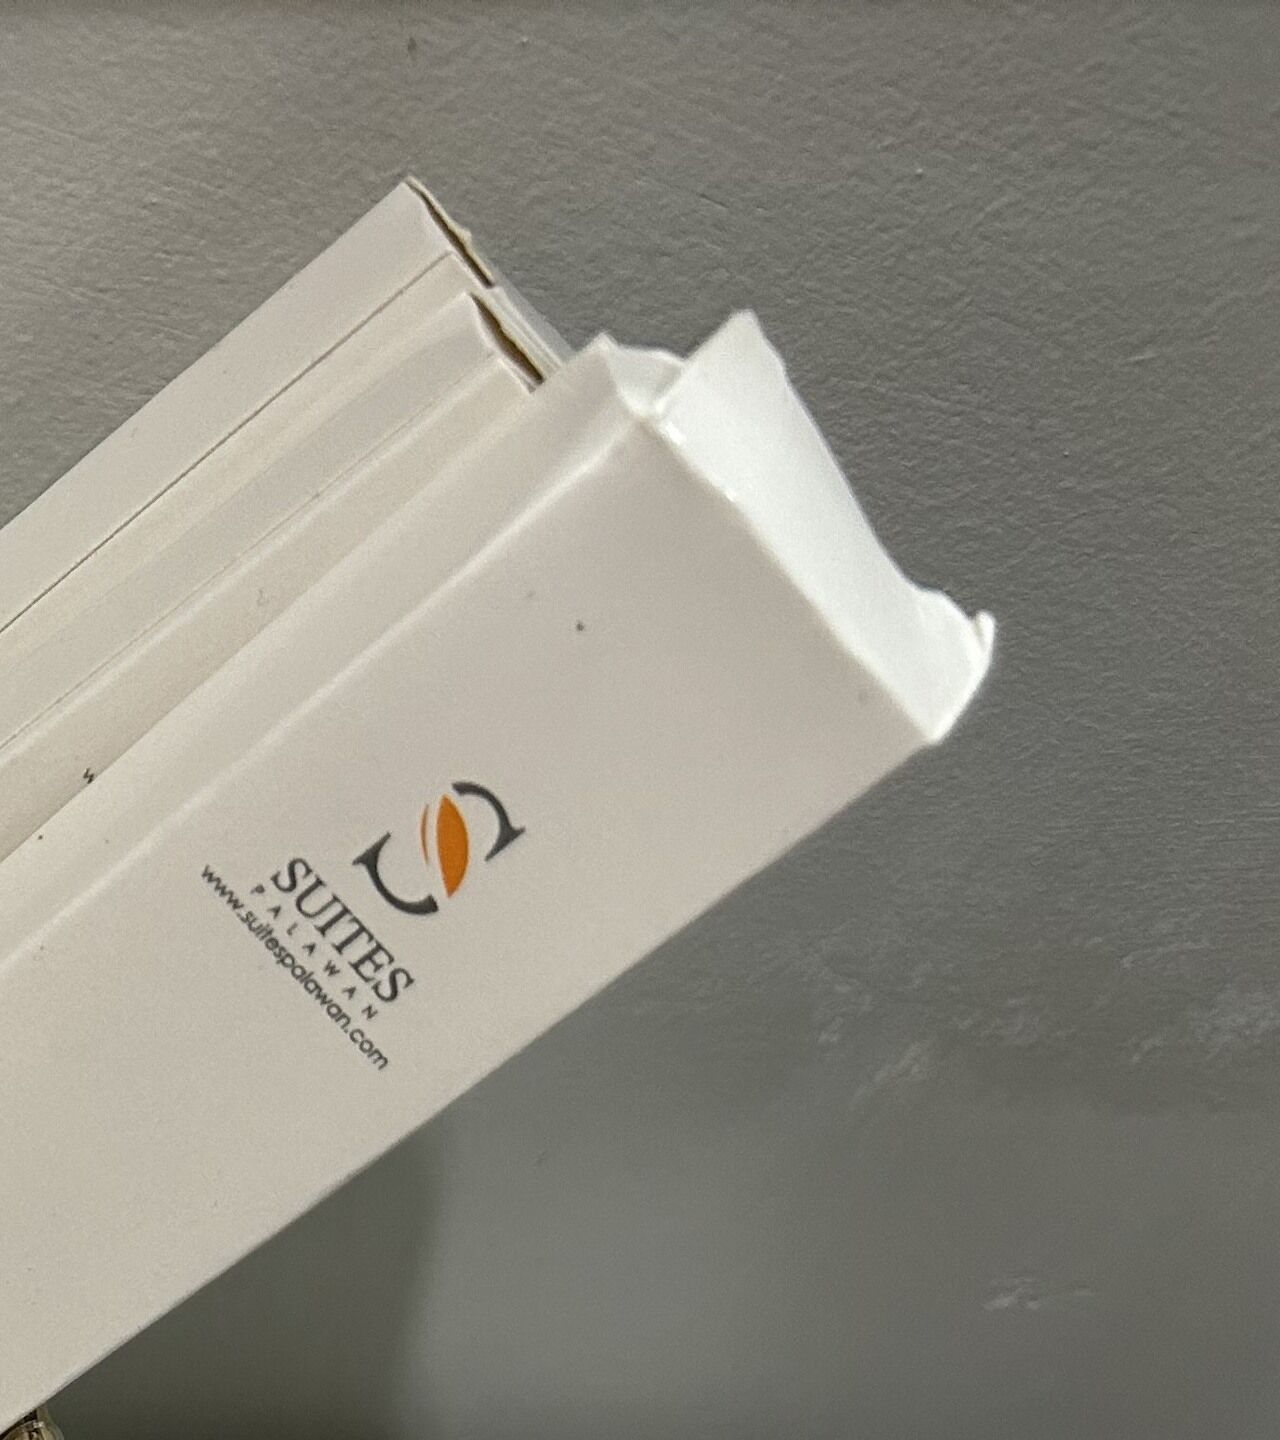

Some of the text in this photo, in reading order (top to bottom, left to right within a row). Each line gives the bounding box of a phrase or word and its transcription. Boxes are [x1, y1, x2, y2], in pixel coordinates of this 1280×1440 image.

[201, 865, 389, 1070] www.suitespalawan.com
[250, 883, 378, 1020] PALAWAN
[270, 857, 414, 1003] SUITES
